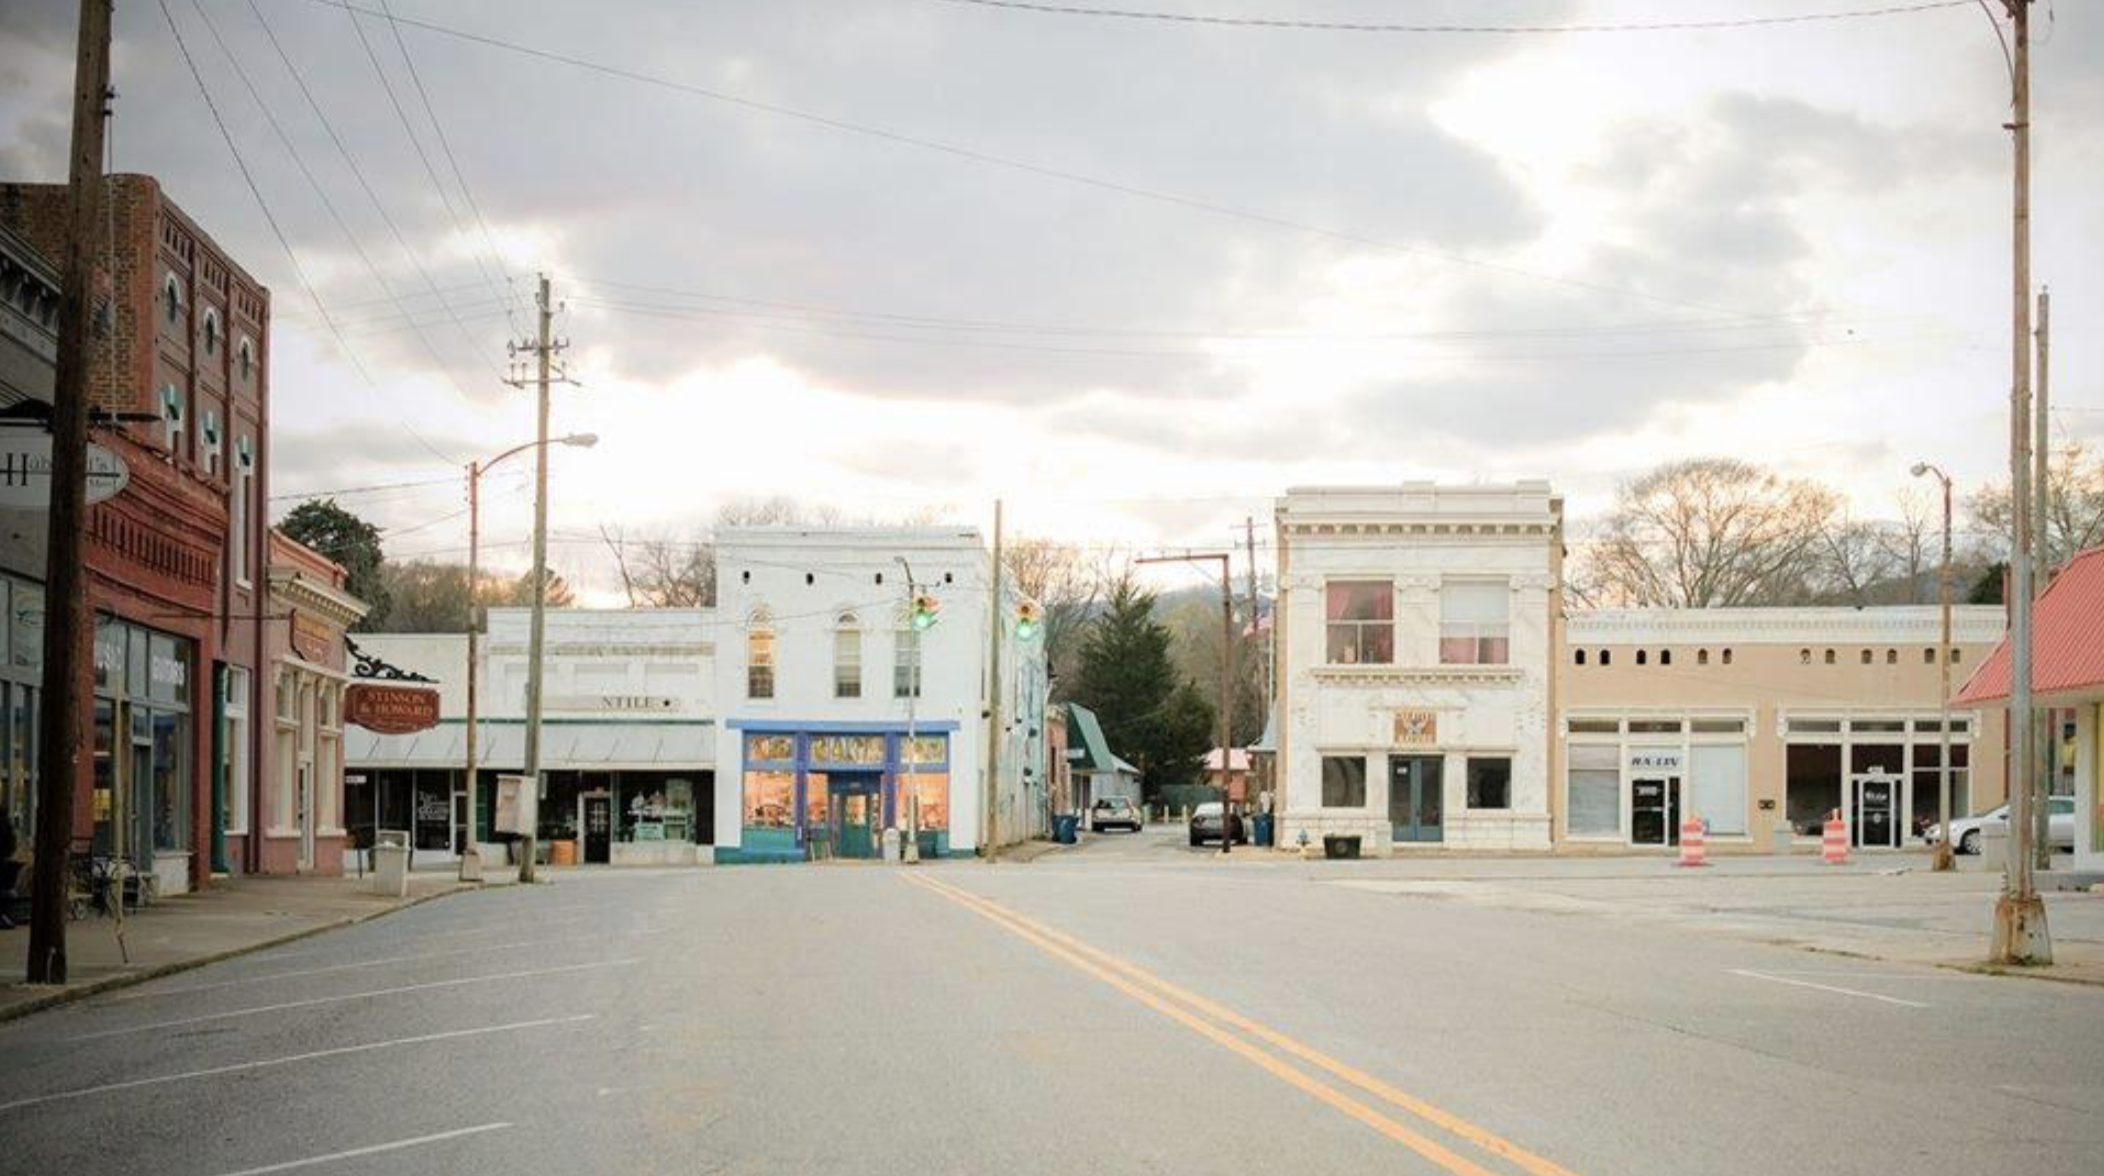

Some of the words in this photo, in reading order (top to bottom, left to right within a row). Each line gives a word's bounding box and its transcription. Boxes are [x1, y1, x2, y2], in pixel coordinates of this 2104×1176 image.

[367, 691, 425, 704] STINSON
[359, 703, 371, 714] &
[375, 703, 433, 717] HOWARD
